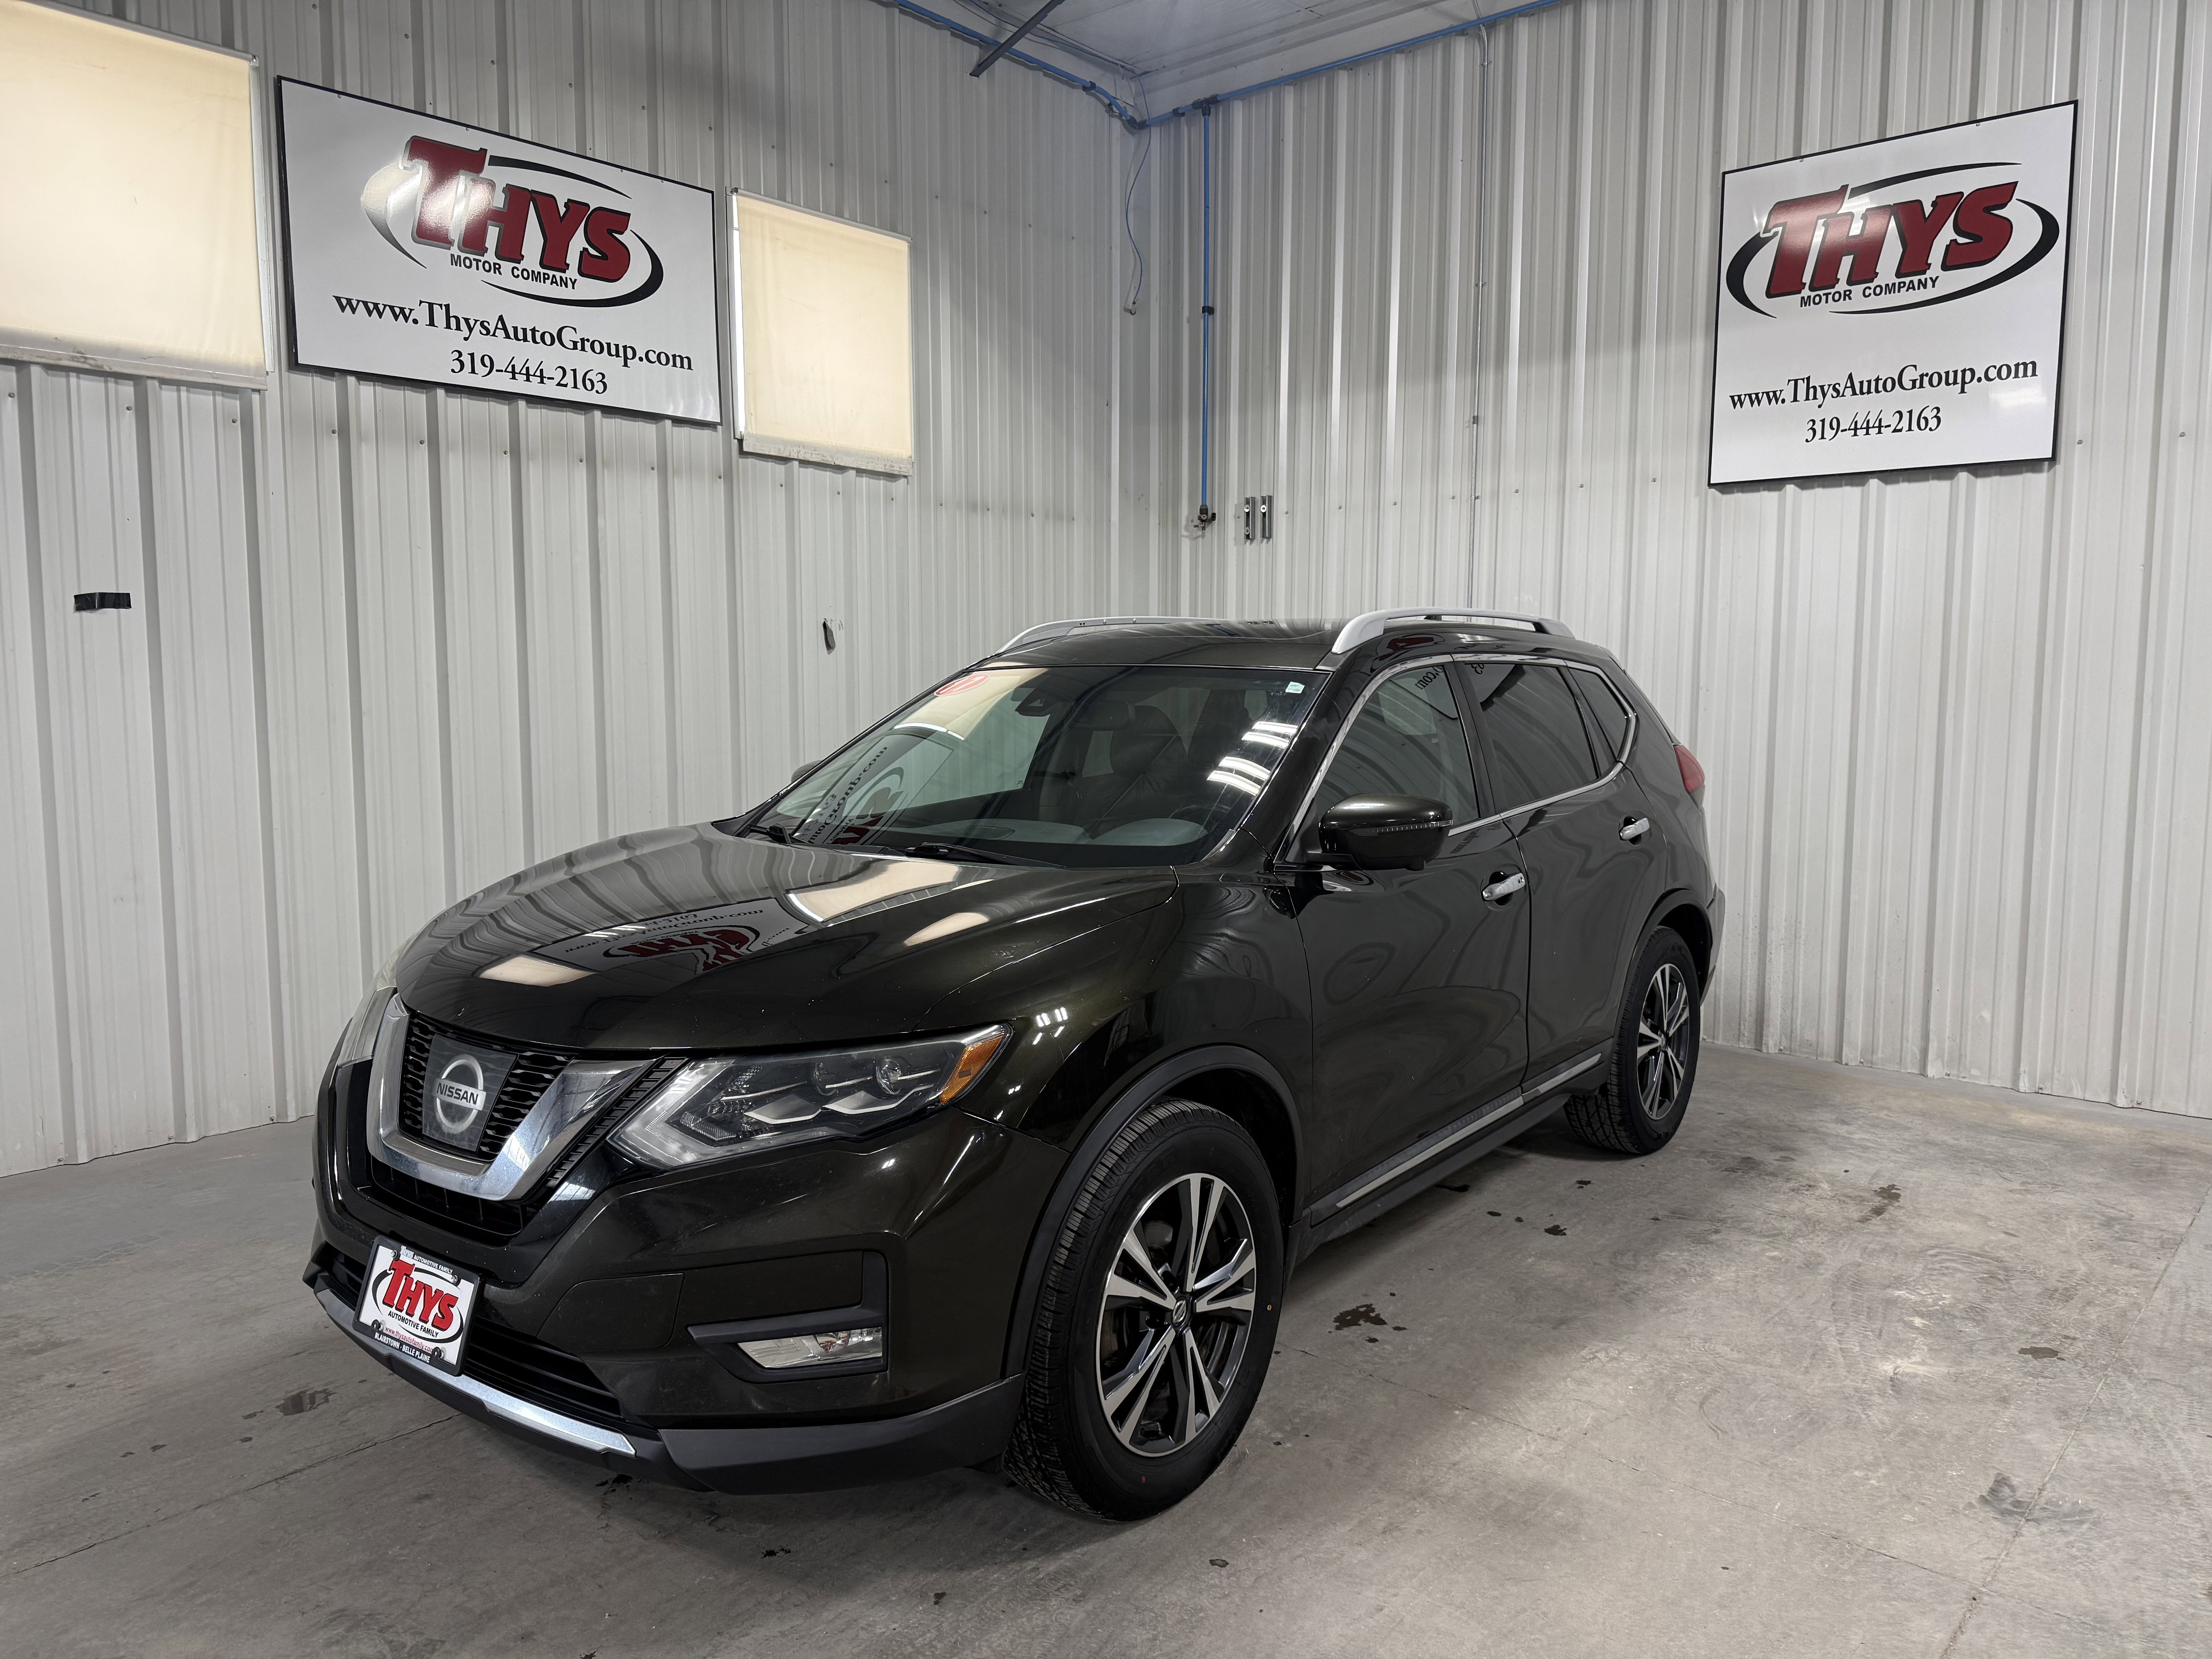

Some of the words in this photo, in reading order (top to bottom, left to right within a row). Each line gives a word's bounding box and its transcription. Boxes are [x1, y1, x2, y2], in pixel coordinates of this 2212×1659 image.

[400, 136, 631, 283] THYS
[1763, 180, 2018, 299] THYS
[450, 253, 503, 276] MOTOR
[511, 266, 578, 290] COMPANY
[1800, 289, 1853, 308] MOTOR
[1862, 275, 1940, 298] COMPANY
[332, 295, 694, 371] www.ThysAutoGroup.com
[450, 349, 608, 394] 319-444-2163
[1729, 360, 2038, 409] www.ThysAutoGroup.com
[1805, 405, 1941, 443] 319-444-2163
[436, 1082, 479, 1105] NISSAN
[413, 1255, 439, 1269] AUTOMOTIVE
[438, 1264, 453, 1274] FAMILY
[382, 1259, 459, 1331] THYS
[388, 1310, 421, 1330] AUTOMOTIVE
[420, 1325, 439, 1338] FAMILY
[374, 1332, 400, 1350] BLAIRSTOWN
[402, 1345, 416, 1356] BELLE
[415, 1351, 431, 1364] PLAINE
